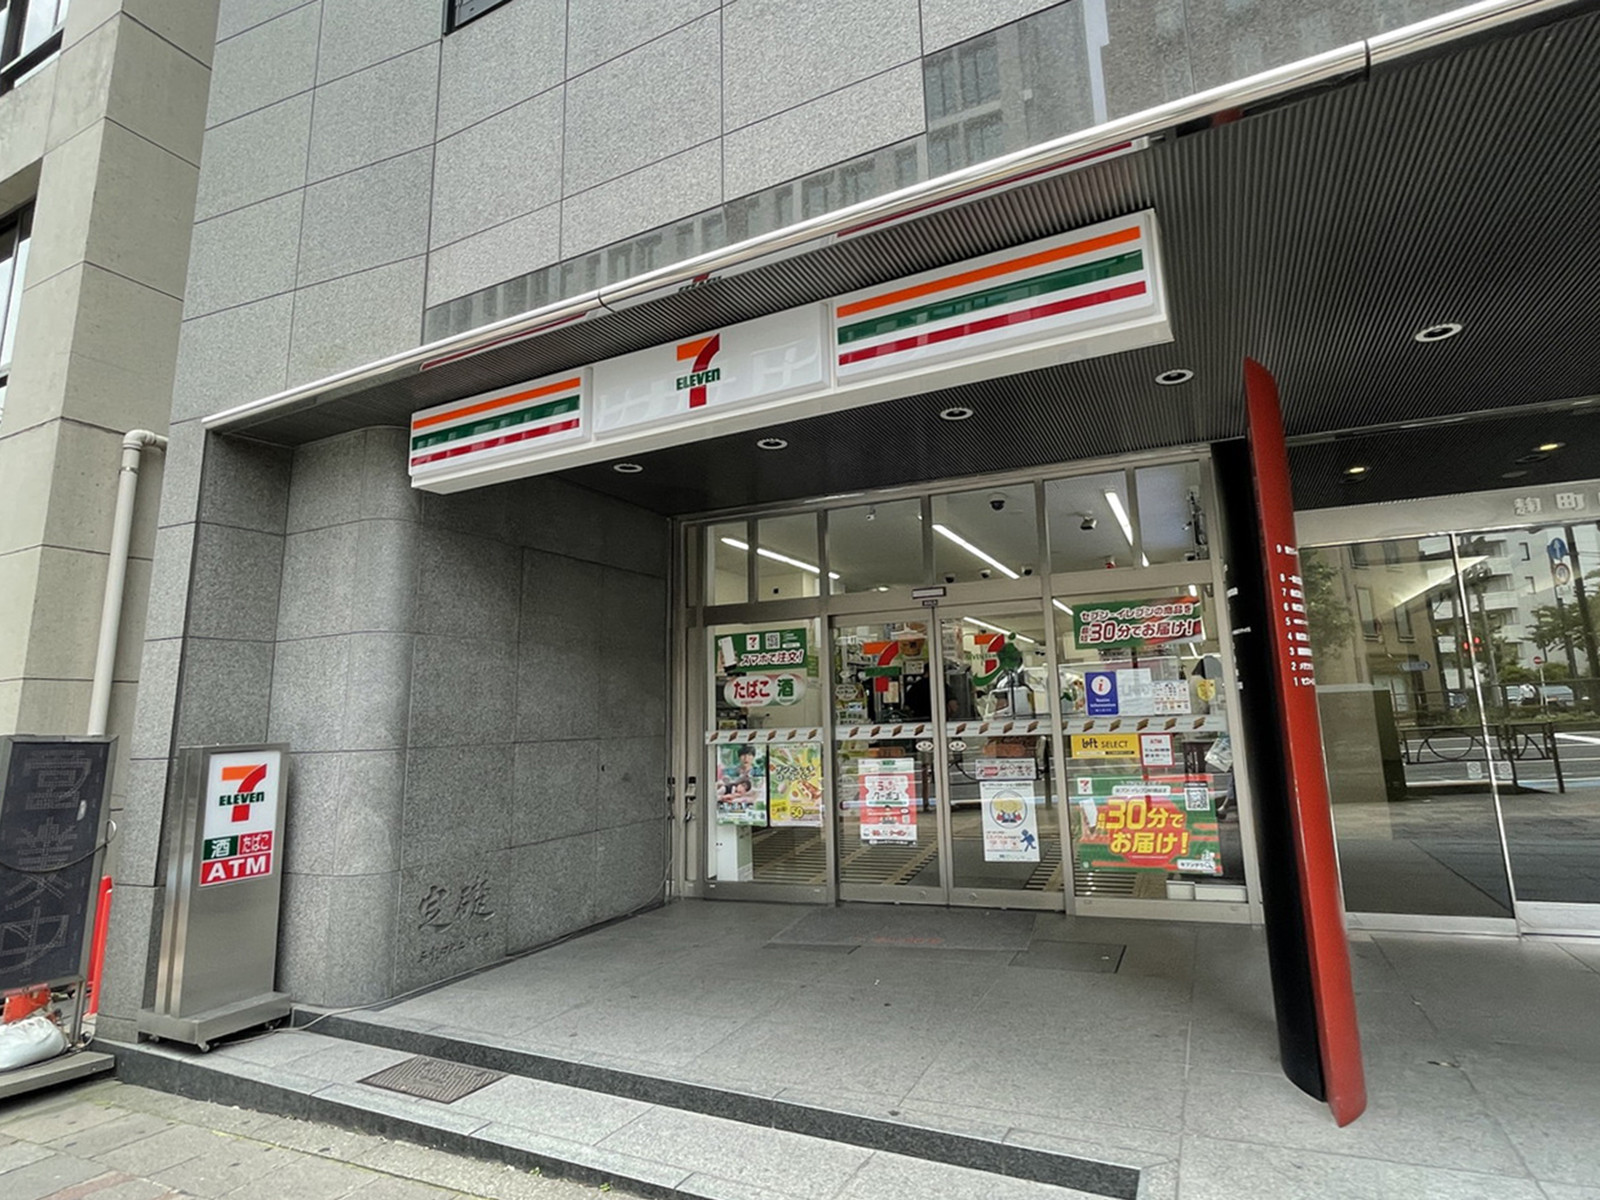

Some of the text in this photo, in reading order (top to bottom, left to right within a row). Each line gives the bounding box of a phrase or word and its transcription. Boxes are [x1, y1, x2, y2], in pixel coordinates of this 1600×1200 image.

[734, 679, 794, 699] たばこ 酒
[1101, 740, 1129, 748] SELECT
[211, 834, 269, 858] 酒 たばこ
[1110, 832, 1190, 854] お届け!
[207, 855, 267, 882] ATM
